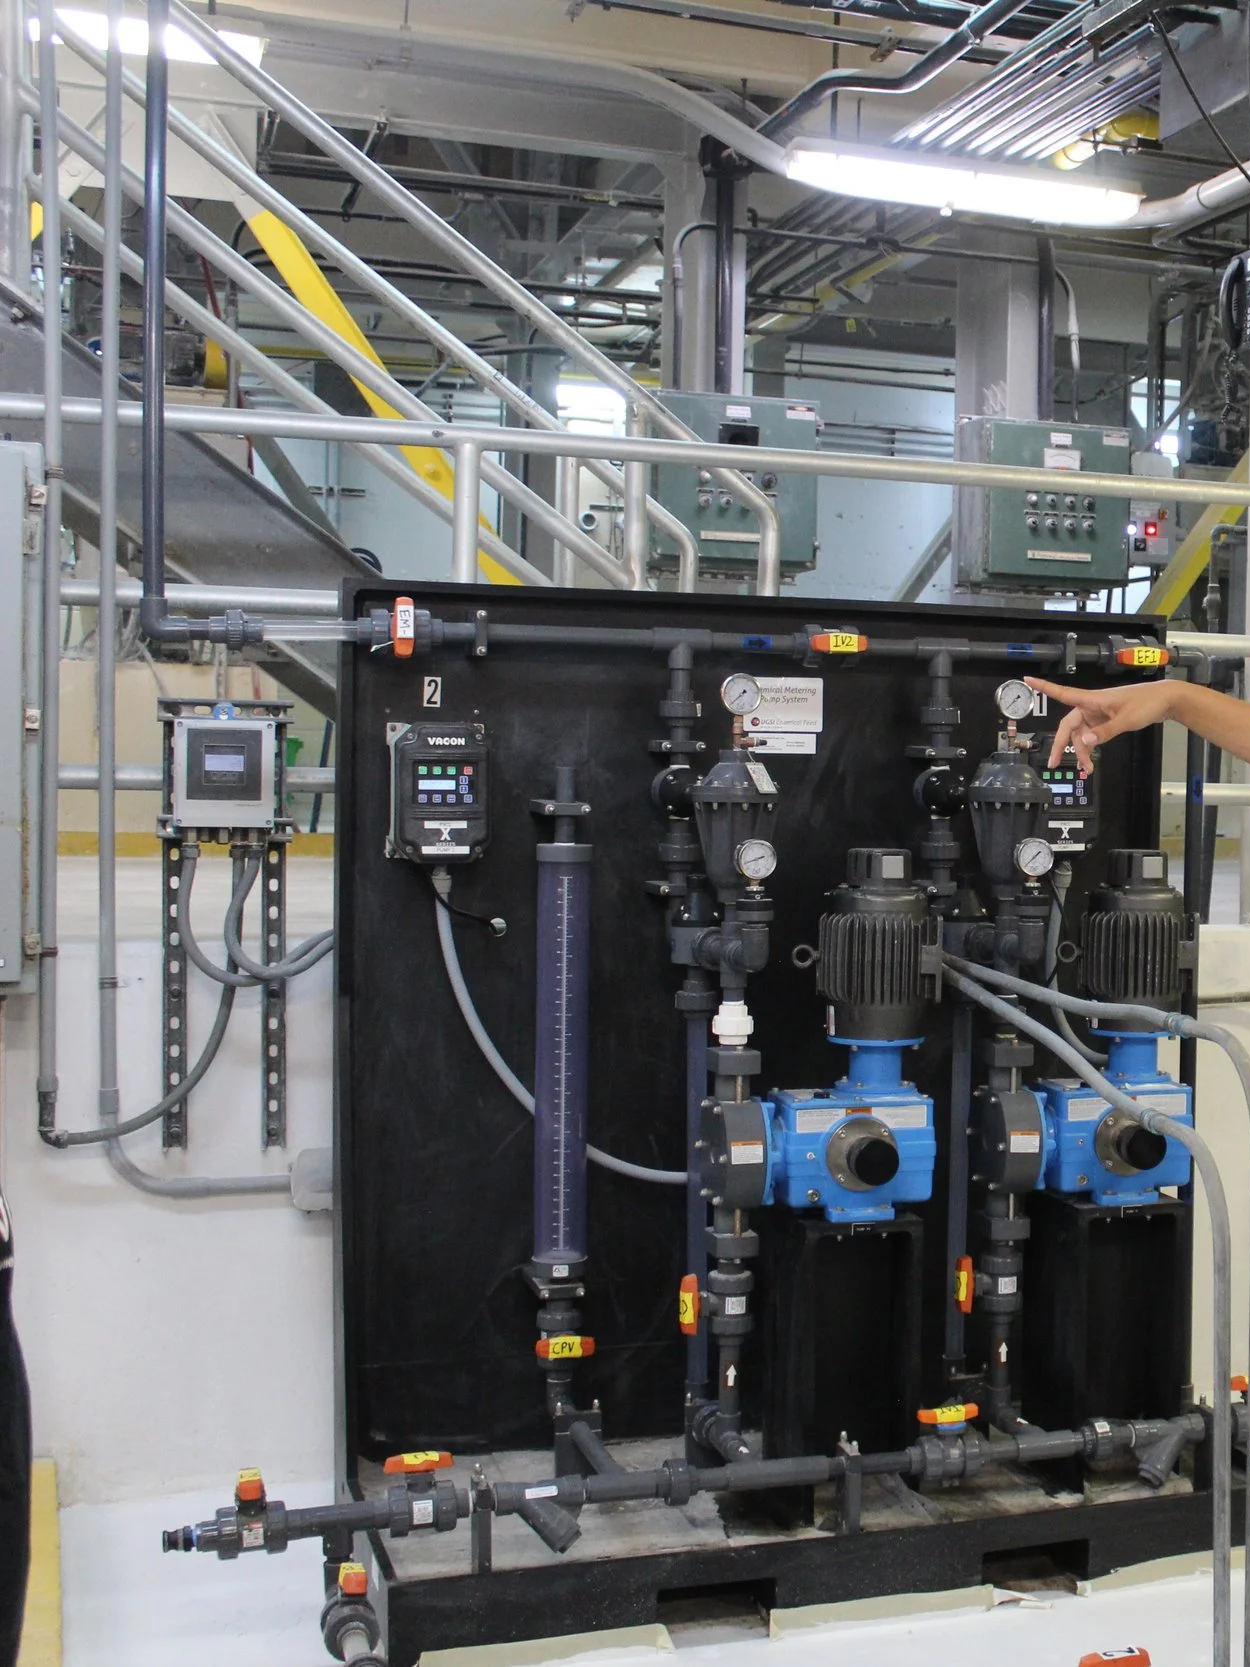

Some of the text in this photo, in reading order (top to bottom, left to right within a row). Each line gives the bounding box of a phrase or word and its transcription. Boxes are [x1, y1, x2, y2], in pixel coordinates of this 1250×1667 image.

[832, 634, 855, 648] IV2
[1138, 650, 1157, 664] EF1
[426, 679, 439, 704] 2
[784, 686, 817, 696] Metering
[781, 695, 809, 704] System
[1036, 692, 1045, 715] 1
[427, 737, 466, 746] VACON
[440, 828, 451, 841] X
[1061, 828, 1070, 839] X
[552, 1342, 575, 1355] CPV
